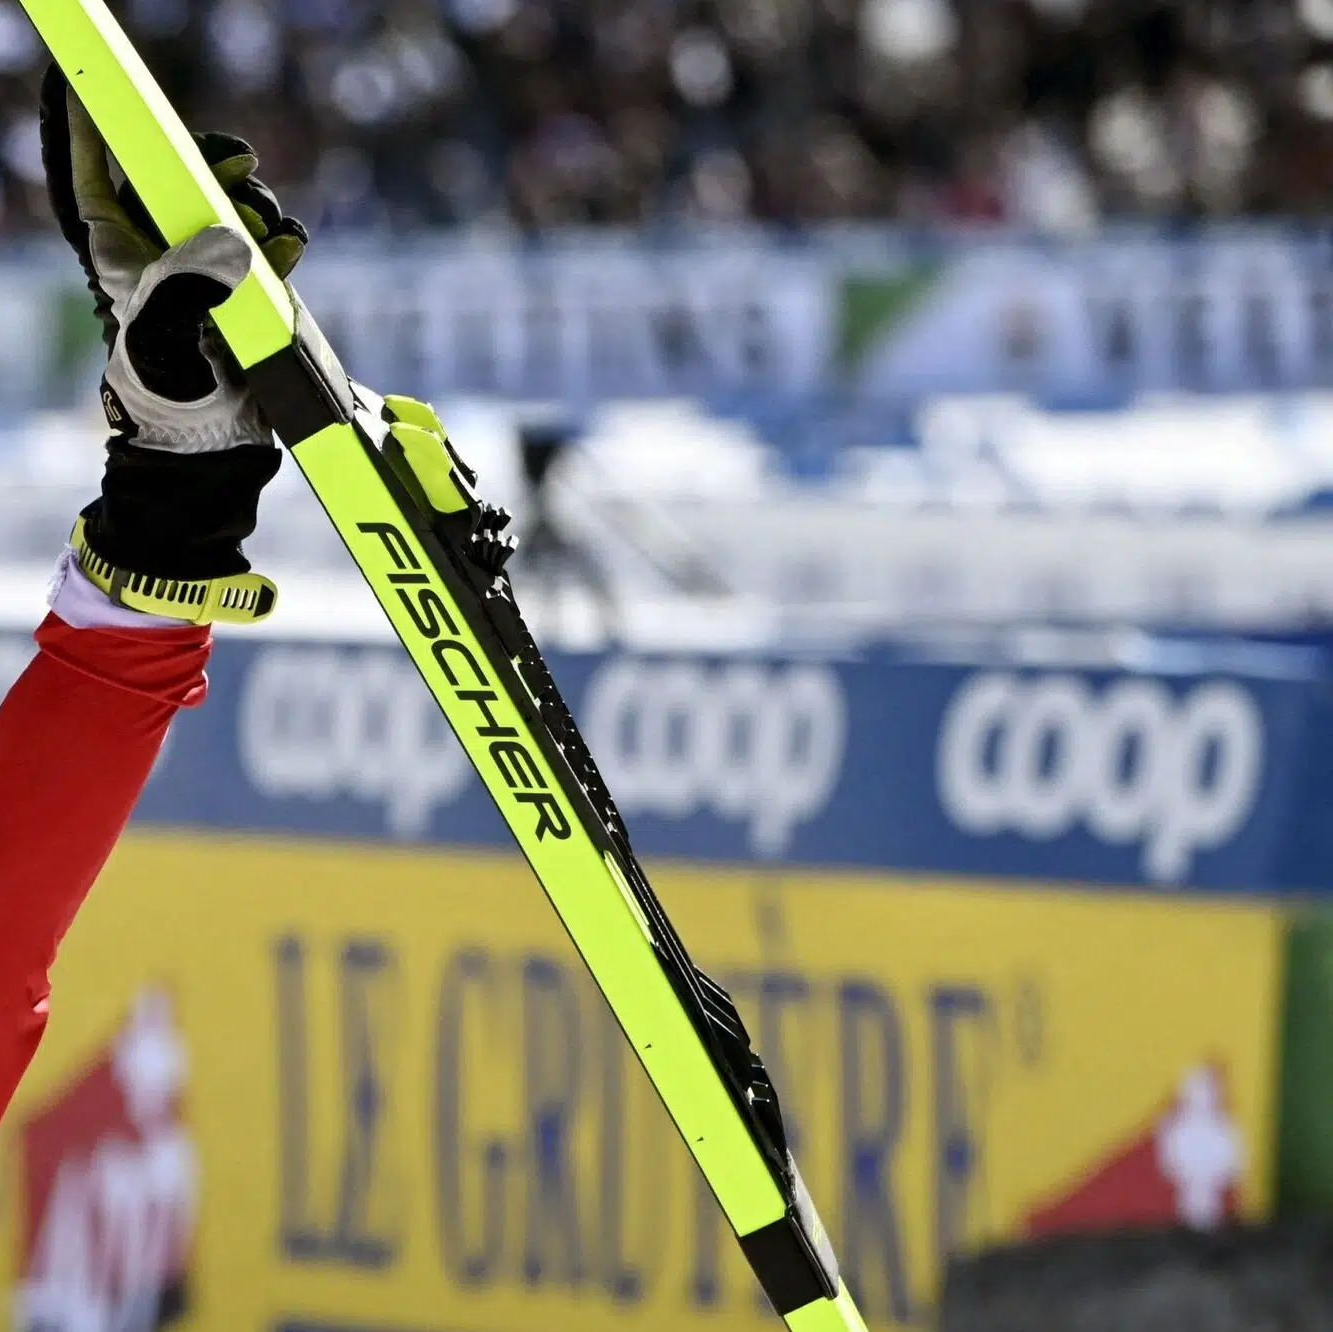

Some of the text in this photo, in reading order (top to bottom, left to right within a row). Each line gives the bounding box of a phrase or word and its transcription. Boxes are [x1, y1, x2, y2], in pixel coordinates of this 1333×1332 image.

[355, 521, 572, 843] FISCHER
[581, 655, 845, 860] coop
[937, 670, 1263, 885] coop
[269, 930, 399, 1270] LE
